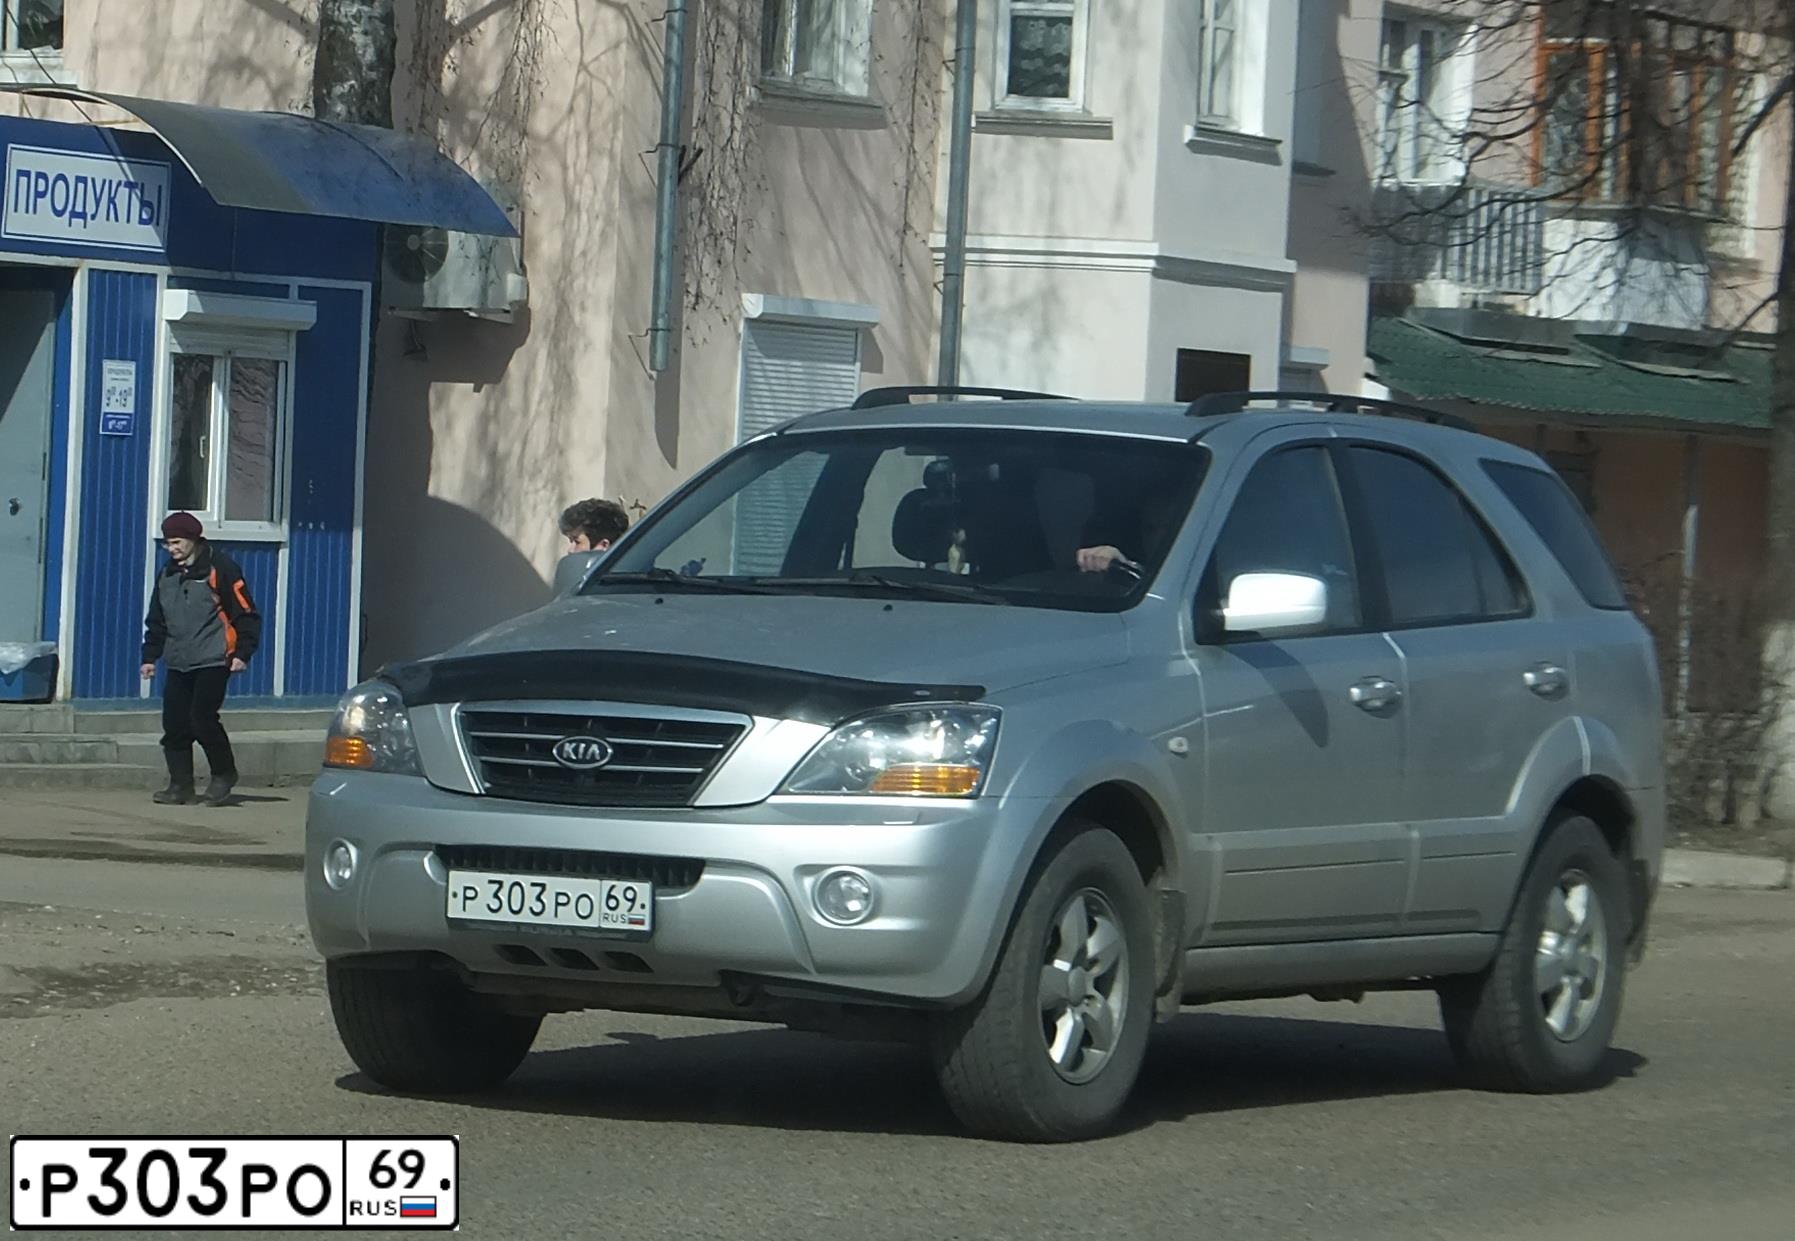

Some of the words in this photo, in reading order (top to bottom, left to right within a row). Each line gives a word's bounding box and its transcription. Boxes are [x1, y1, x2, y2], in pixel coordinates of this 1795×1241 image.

[14, 169, 162, 229] ПРОДУКТЫ
[562, 742, 601, 760] KIA
[605, 884, 638, 913] 69
[602, 912, 626, 924] RUS
